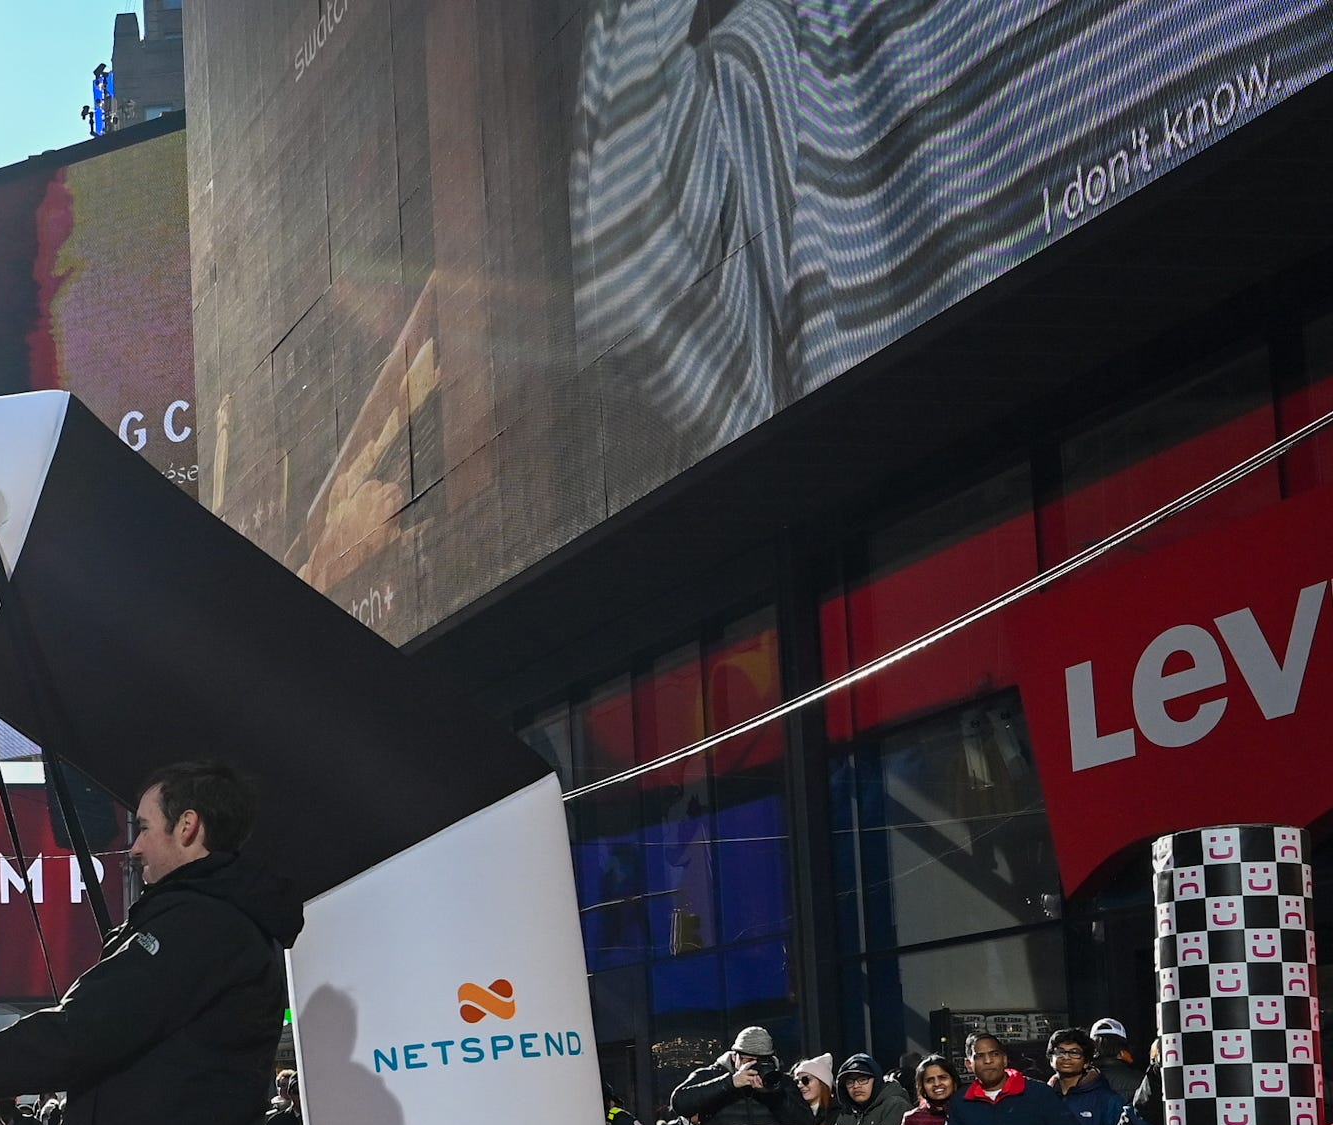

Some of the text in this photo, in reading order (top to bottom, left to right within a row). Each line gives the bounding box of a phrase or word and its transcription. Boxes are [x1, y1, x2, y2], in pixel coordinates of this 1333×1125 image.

[294, 0, 348, 82] swatc
[1043, 54, 1283, 235] I don't know.
[161, 463, 199, 484] ése
[1064, 578, 1333, 773] Lev
[373, 1030, 582, 1074] NETSPEND
